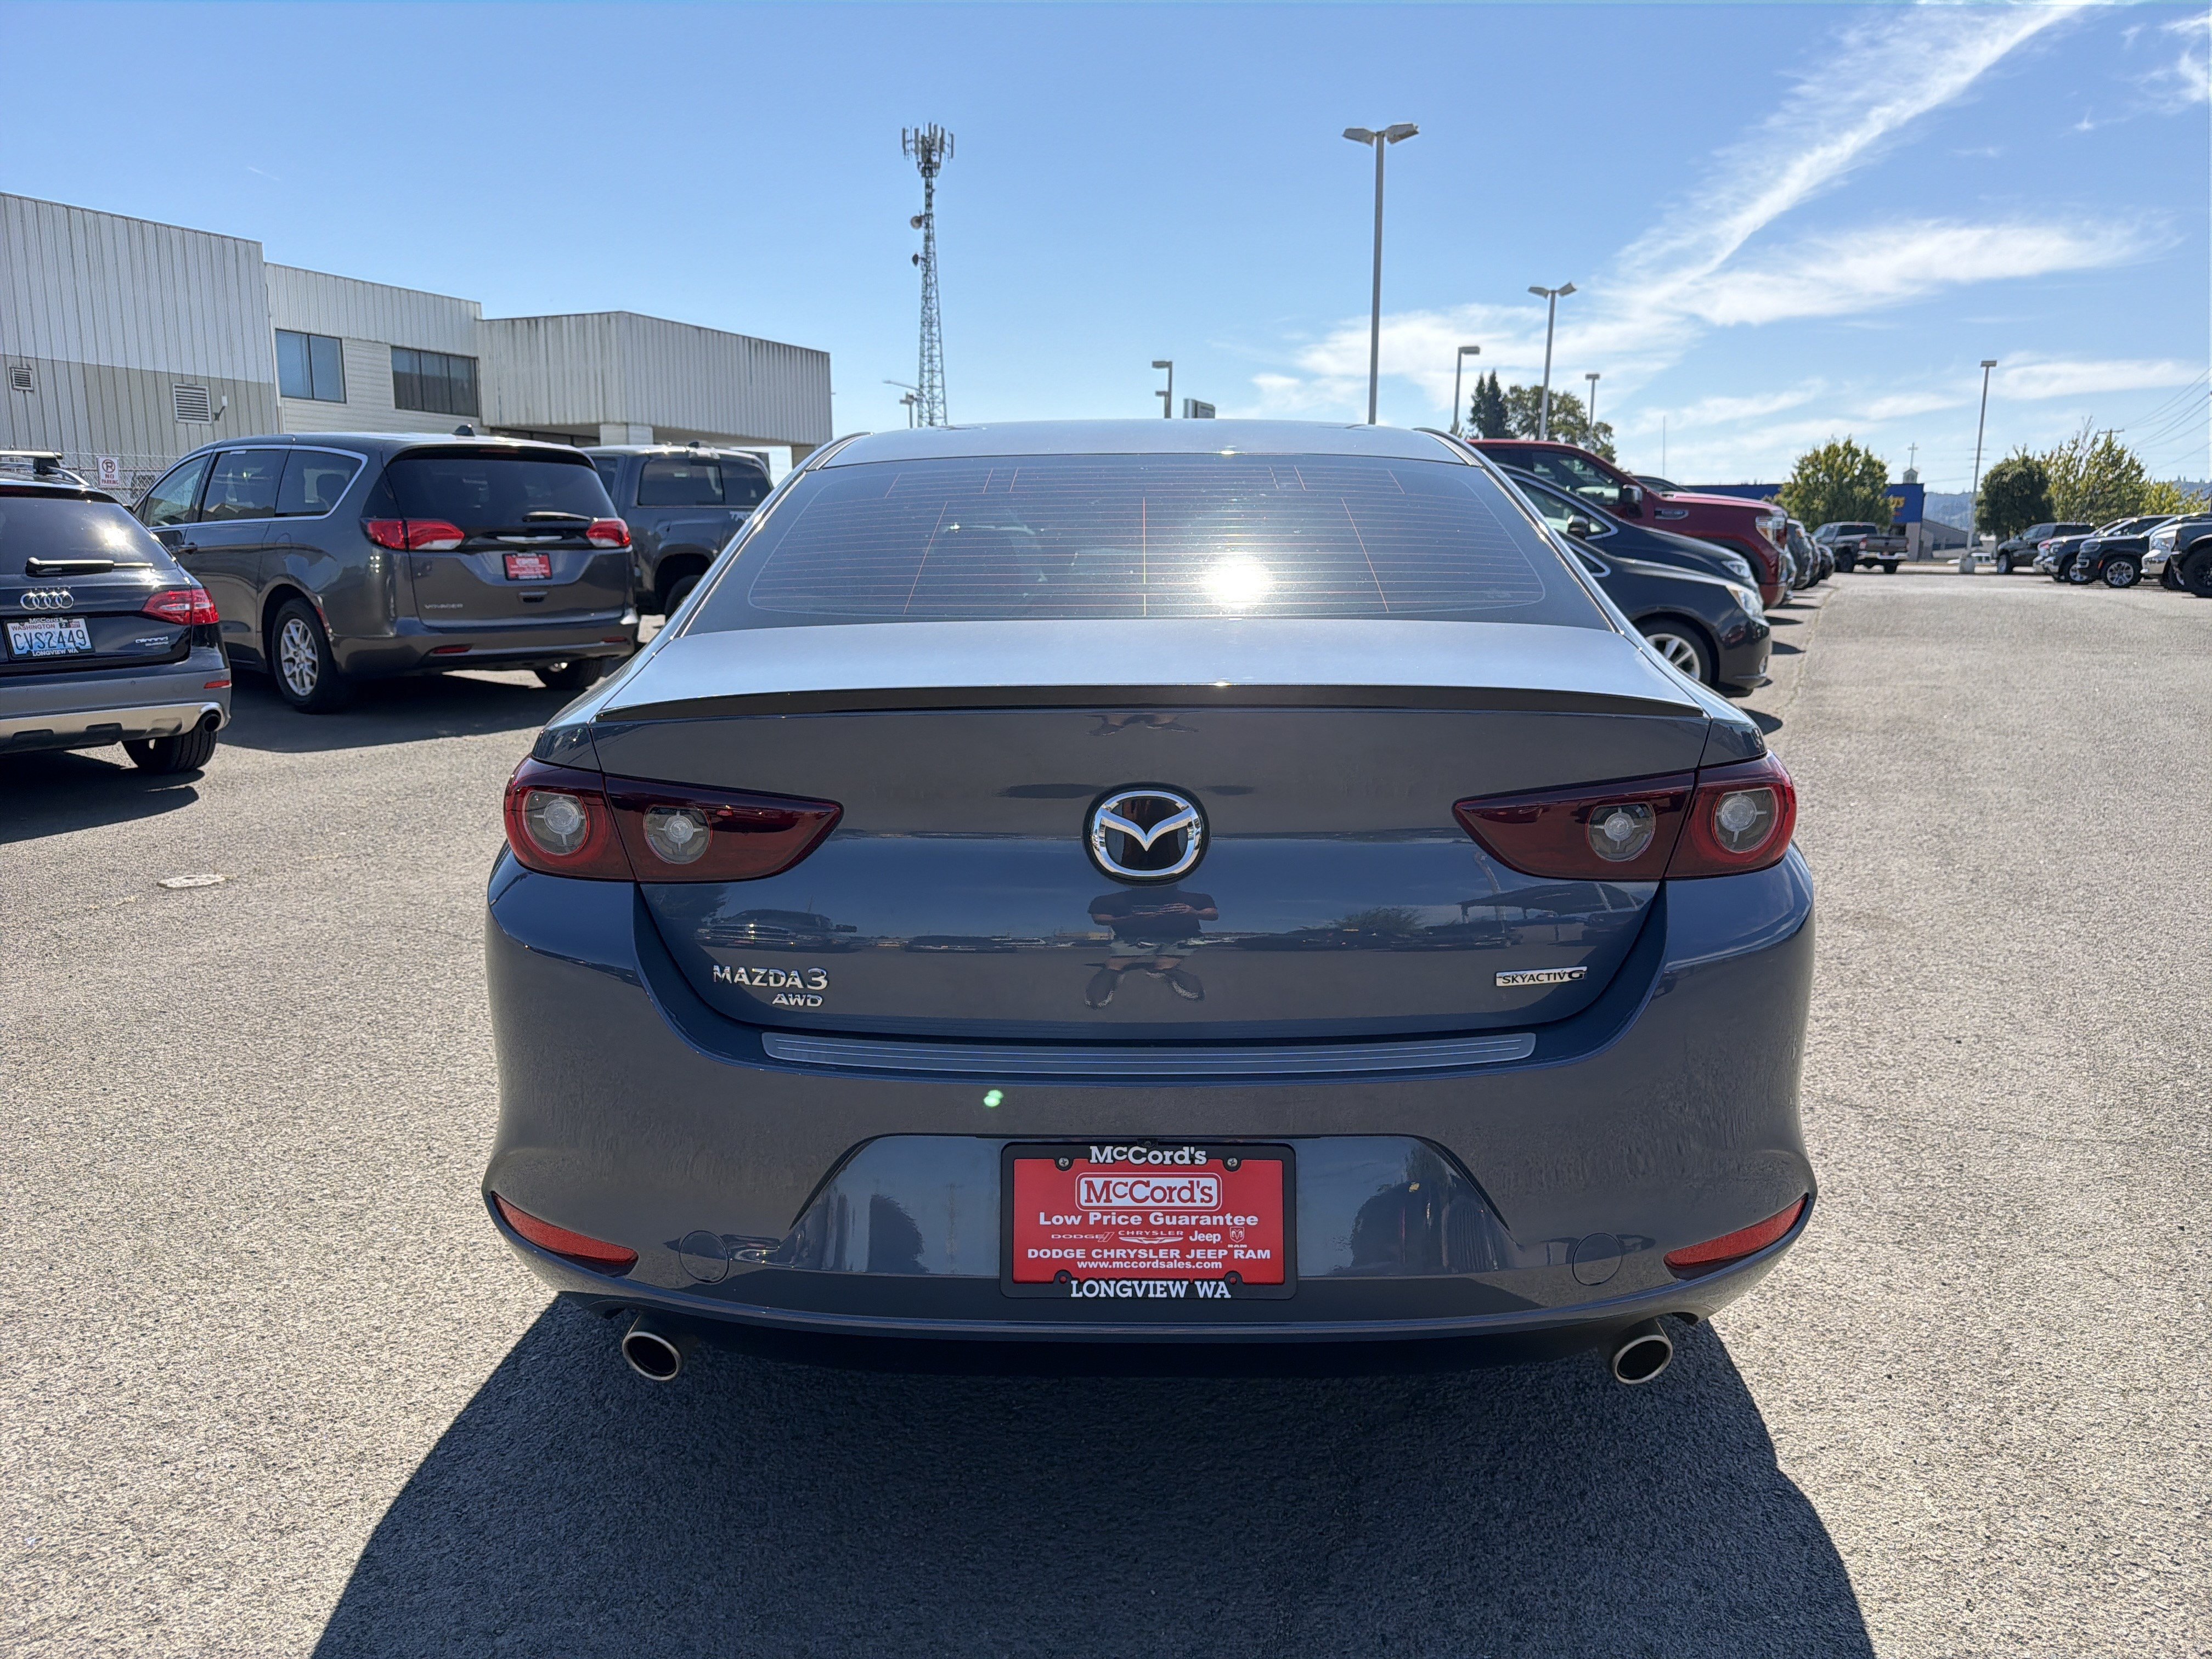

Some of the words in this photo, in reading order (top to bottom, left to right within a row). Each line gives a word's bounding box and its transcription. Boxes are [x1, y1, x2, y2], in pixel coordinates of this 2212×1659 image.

[11, 623, 56, 631] WASHINGTON
[13, 629, 87, 651] CVS2449
[32, 648, 66, 657] LONGVIEW
[772, 992, 823, 1007] AWD
[1090, 1146, 1207, 1165] McCord's
[1084, 1180, 1214, 1204] McCord's
[1039, 1212, 1081, 1226] Low
[1089, 1212, 1142, 1226] Price
[1149, 1212, 1259, 1226] Guarantee
[1189, 1230, 1221, 1244] Jeep
[1028, 1249, 1086, 1259] DODGE
[1091, 1249, 1181, 1259] CHRYSLER
[1185, 1249, 1228, 1259] JEEP
[1233, 1249, 1271, 1259] RAM
[1076, 1260, 1222, 1269] www.mccordsales.com
[1070, 1280, 1188, 1298] LONGVIEW
[1195, 1281, 1231, 1299] WA
